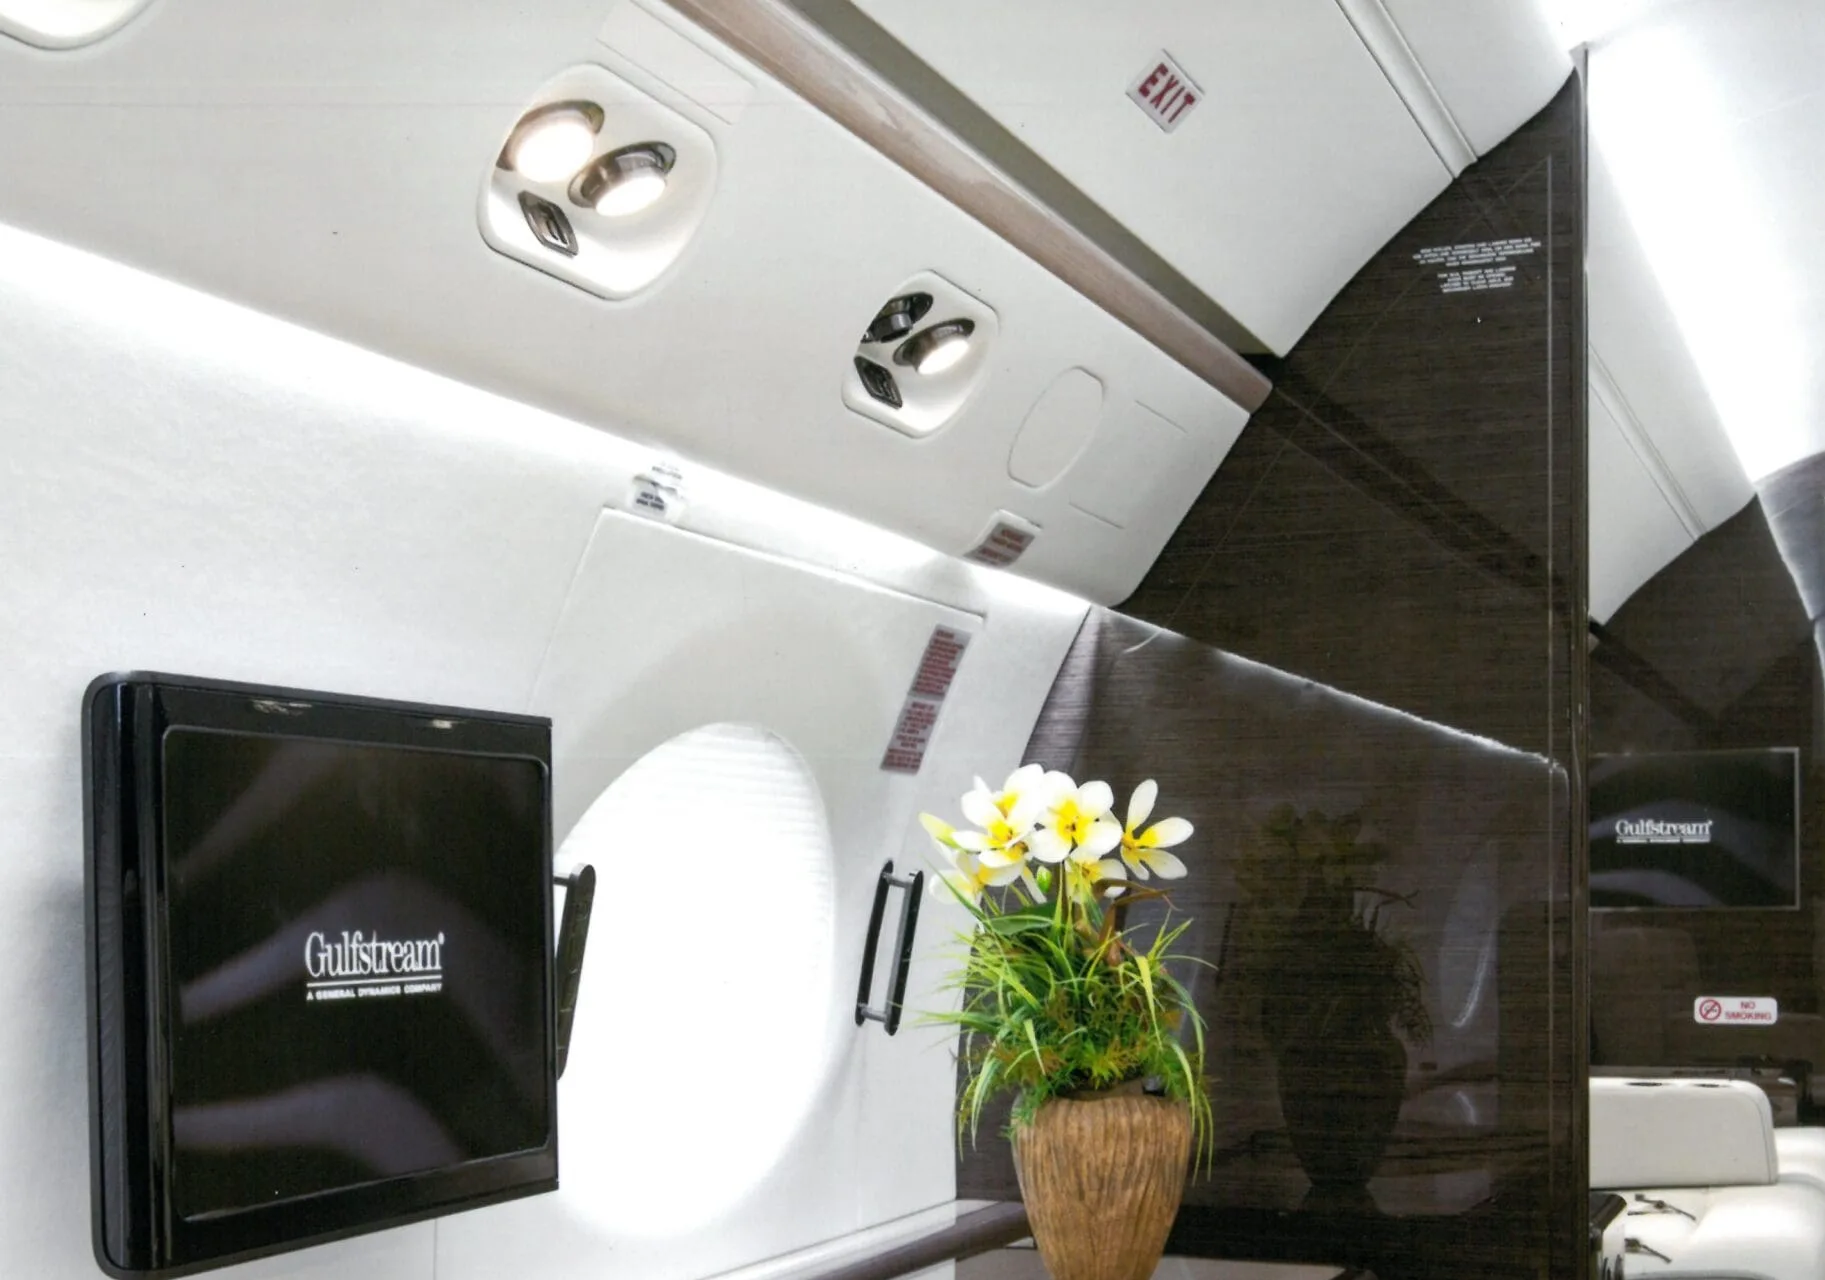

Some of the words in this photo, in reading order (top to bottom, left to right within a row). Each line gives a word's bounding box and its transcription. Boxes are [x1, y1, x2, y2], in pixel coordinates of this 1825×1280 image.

[1138, 62, 1196, 123] EXIT
[1615, 819, 1710, 835] Gulfstream
[306, 930, 442, 978] Gulfstream
[306, 990, 314, 1000] A
[316, 988, 356, 1000] GENERAL
[358, 985, 401, 997] DYNAMICS
[404, 983, 442, 994] COMPANY
[1740, 1001, 1756, 1009] NO
[1725, 1011, 1772, 1020] SMOKING
